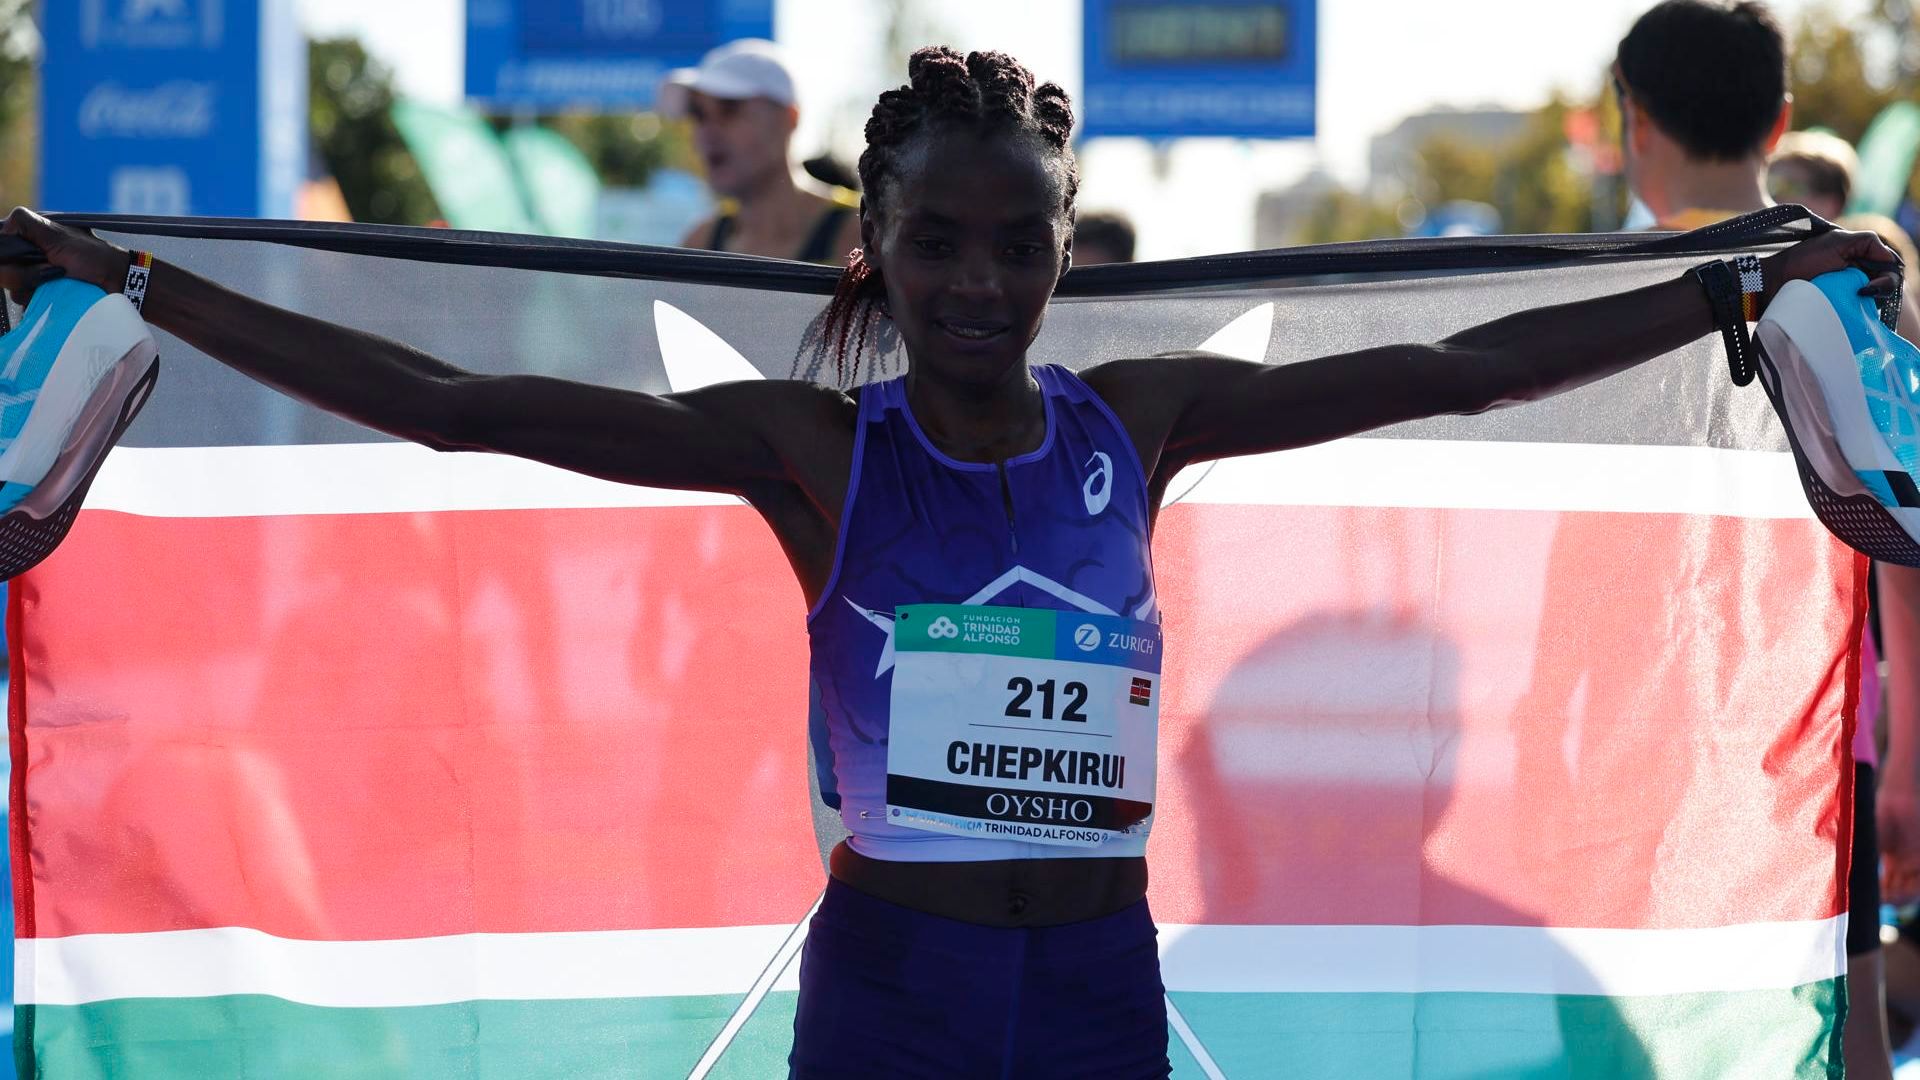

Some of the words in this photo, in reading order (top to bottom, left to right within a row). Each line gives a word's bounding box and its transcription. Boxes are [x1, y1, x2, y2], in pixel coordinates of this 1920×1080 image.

[963, 622, 1020, 635] TRINIDAD
[963, 634, 1020, 645] ALFONSO
[1109, 632, 1154, 654] ZURICH
[1004, 676, 1088, 723] 212
[946, 740, 1125, 789] CHEPKIRUI
[986, 793, 1092, 822] OYSHO
[985, 822, 1043, 838] TRINIDAD
[1043, 828, 1100, 842] ALFONSO
